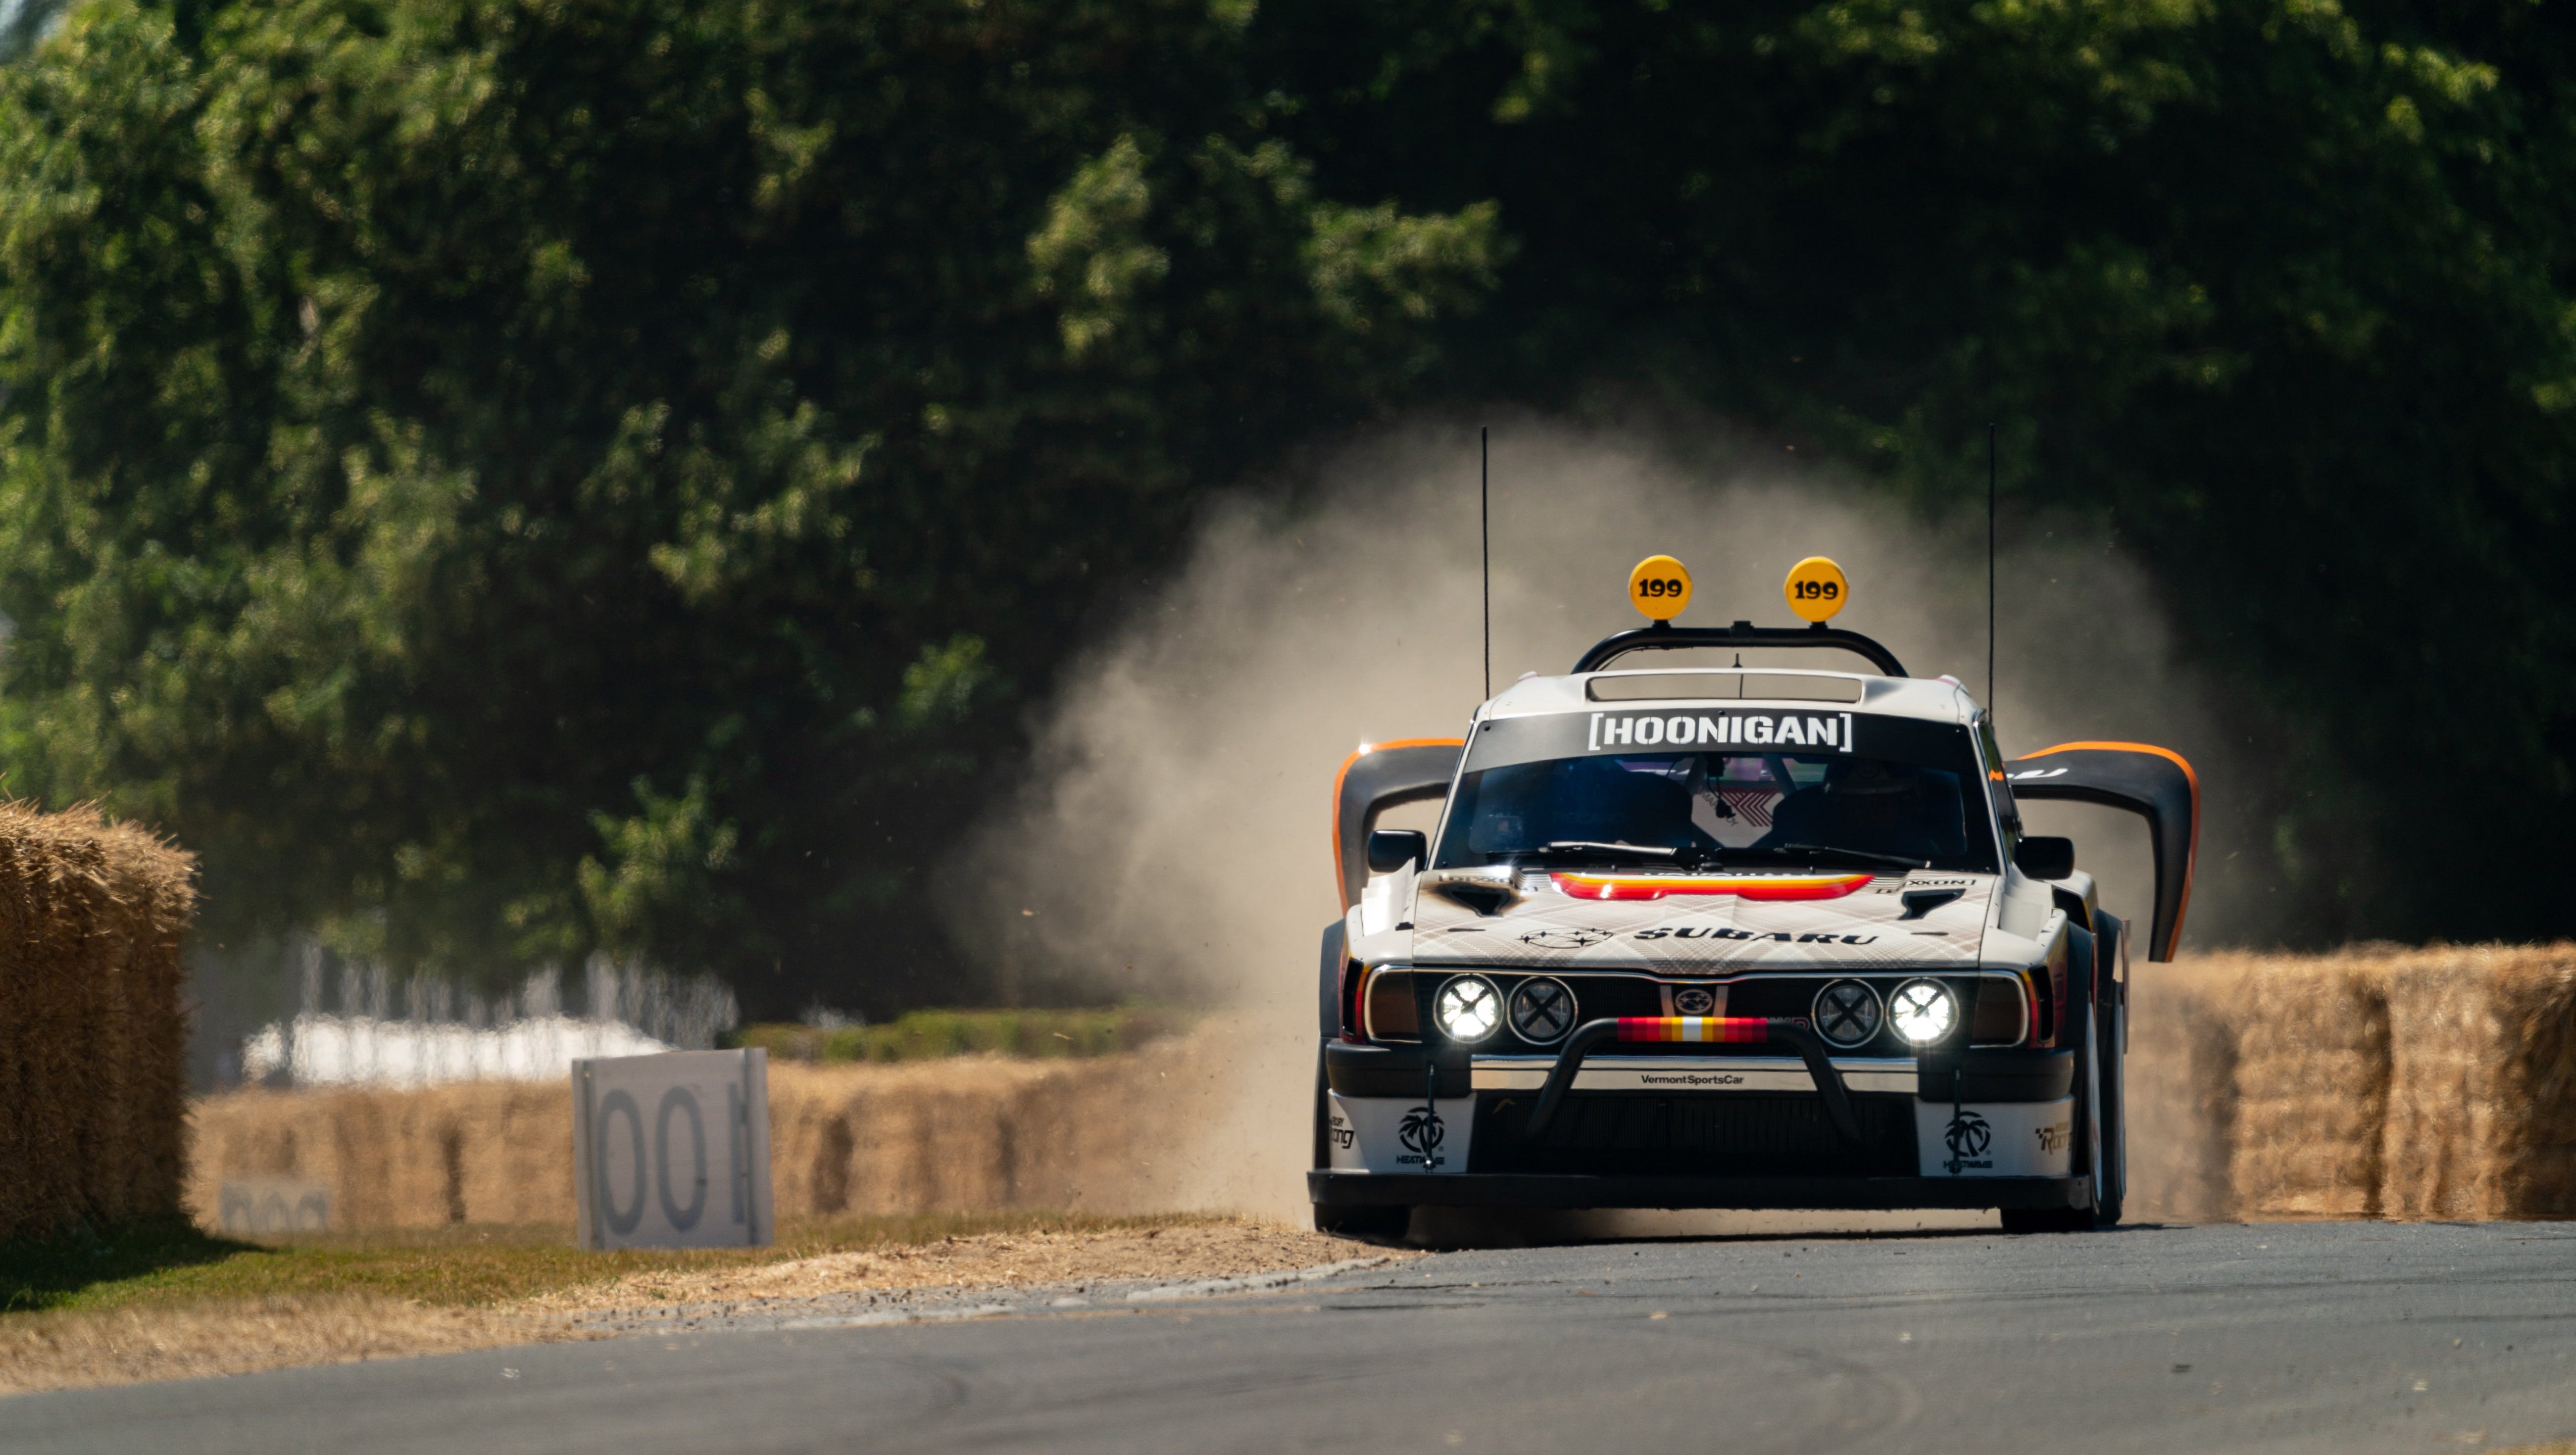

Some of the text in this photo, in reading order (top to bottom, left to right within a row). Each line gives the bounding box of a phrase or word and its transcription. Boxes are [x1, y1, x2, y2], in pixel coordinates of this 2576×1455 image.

[1639, 578, 1682, 598] 199
[1794, 580, 1839, 600] 199
[1634, 928, 1878, 945] SUBARU
